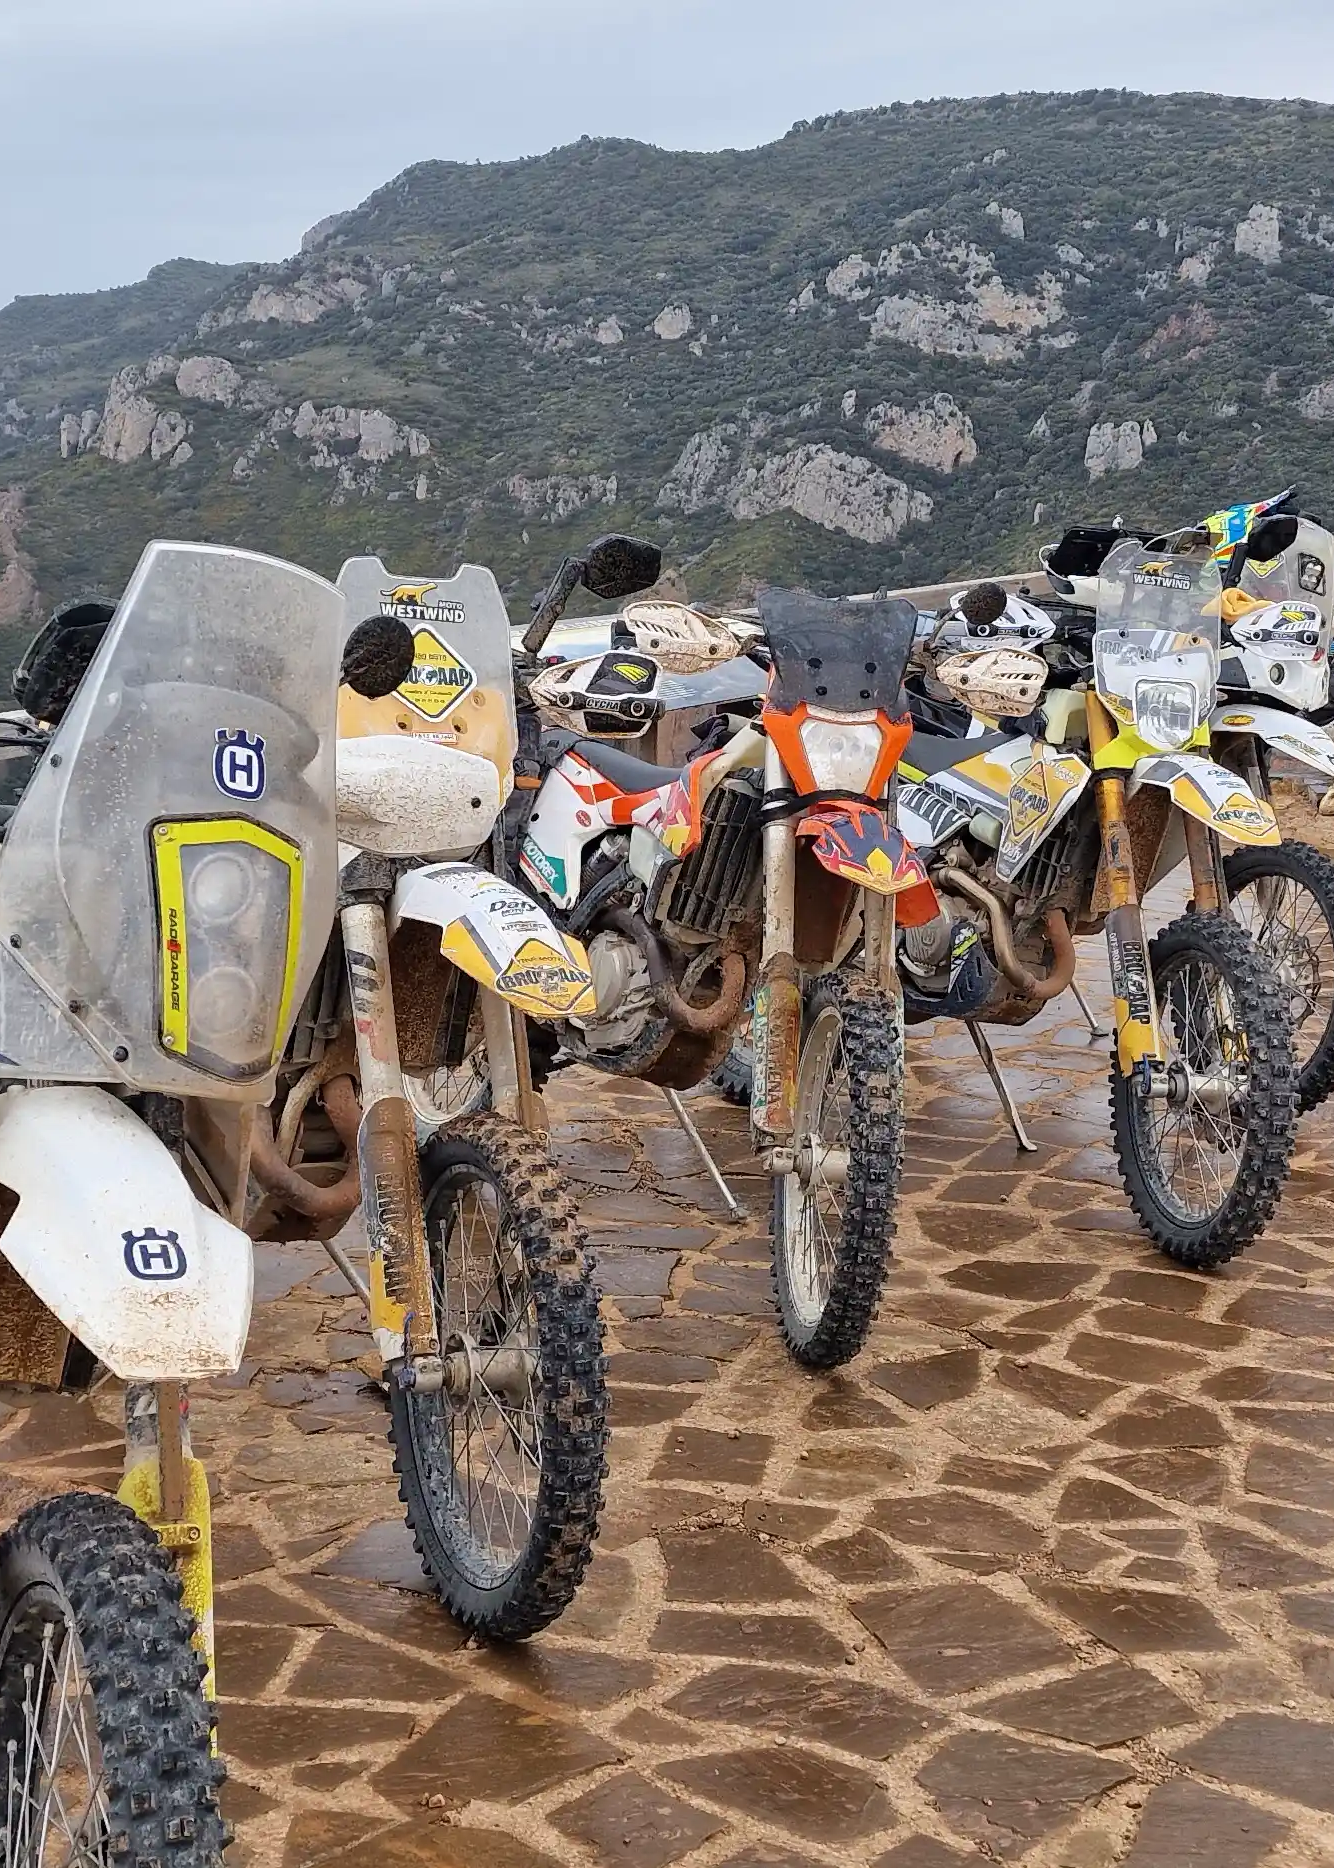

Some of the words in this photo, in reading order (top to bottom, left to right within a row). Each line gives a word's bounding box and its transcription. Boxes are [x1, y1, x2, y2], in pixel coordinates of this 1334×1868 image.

[1133, 573, 1191, 590] WESTWIND
[380, 602, 465, 623] WESTWIND
[438, 600, 464, 610] MOTO
[489, 900, 538, 914] Dafy
